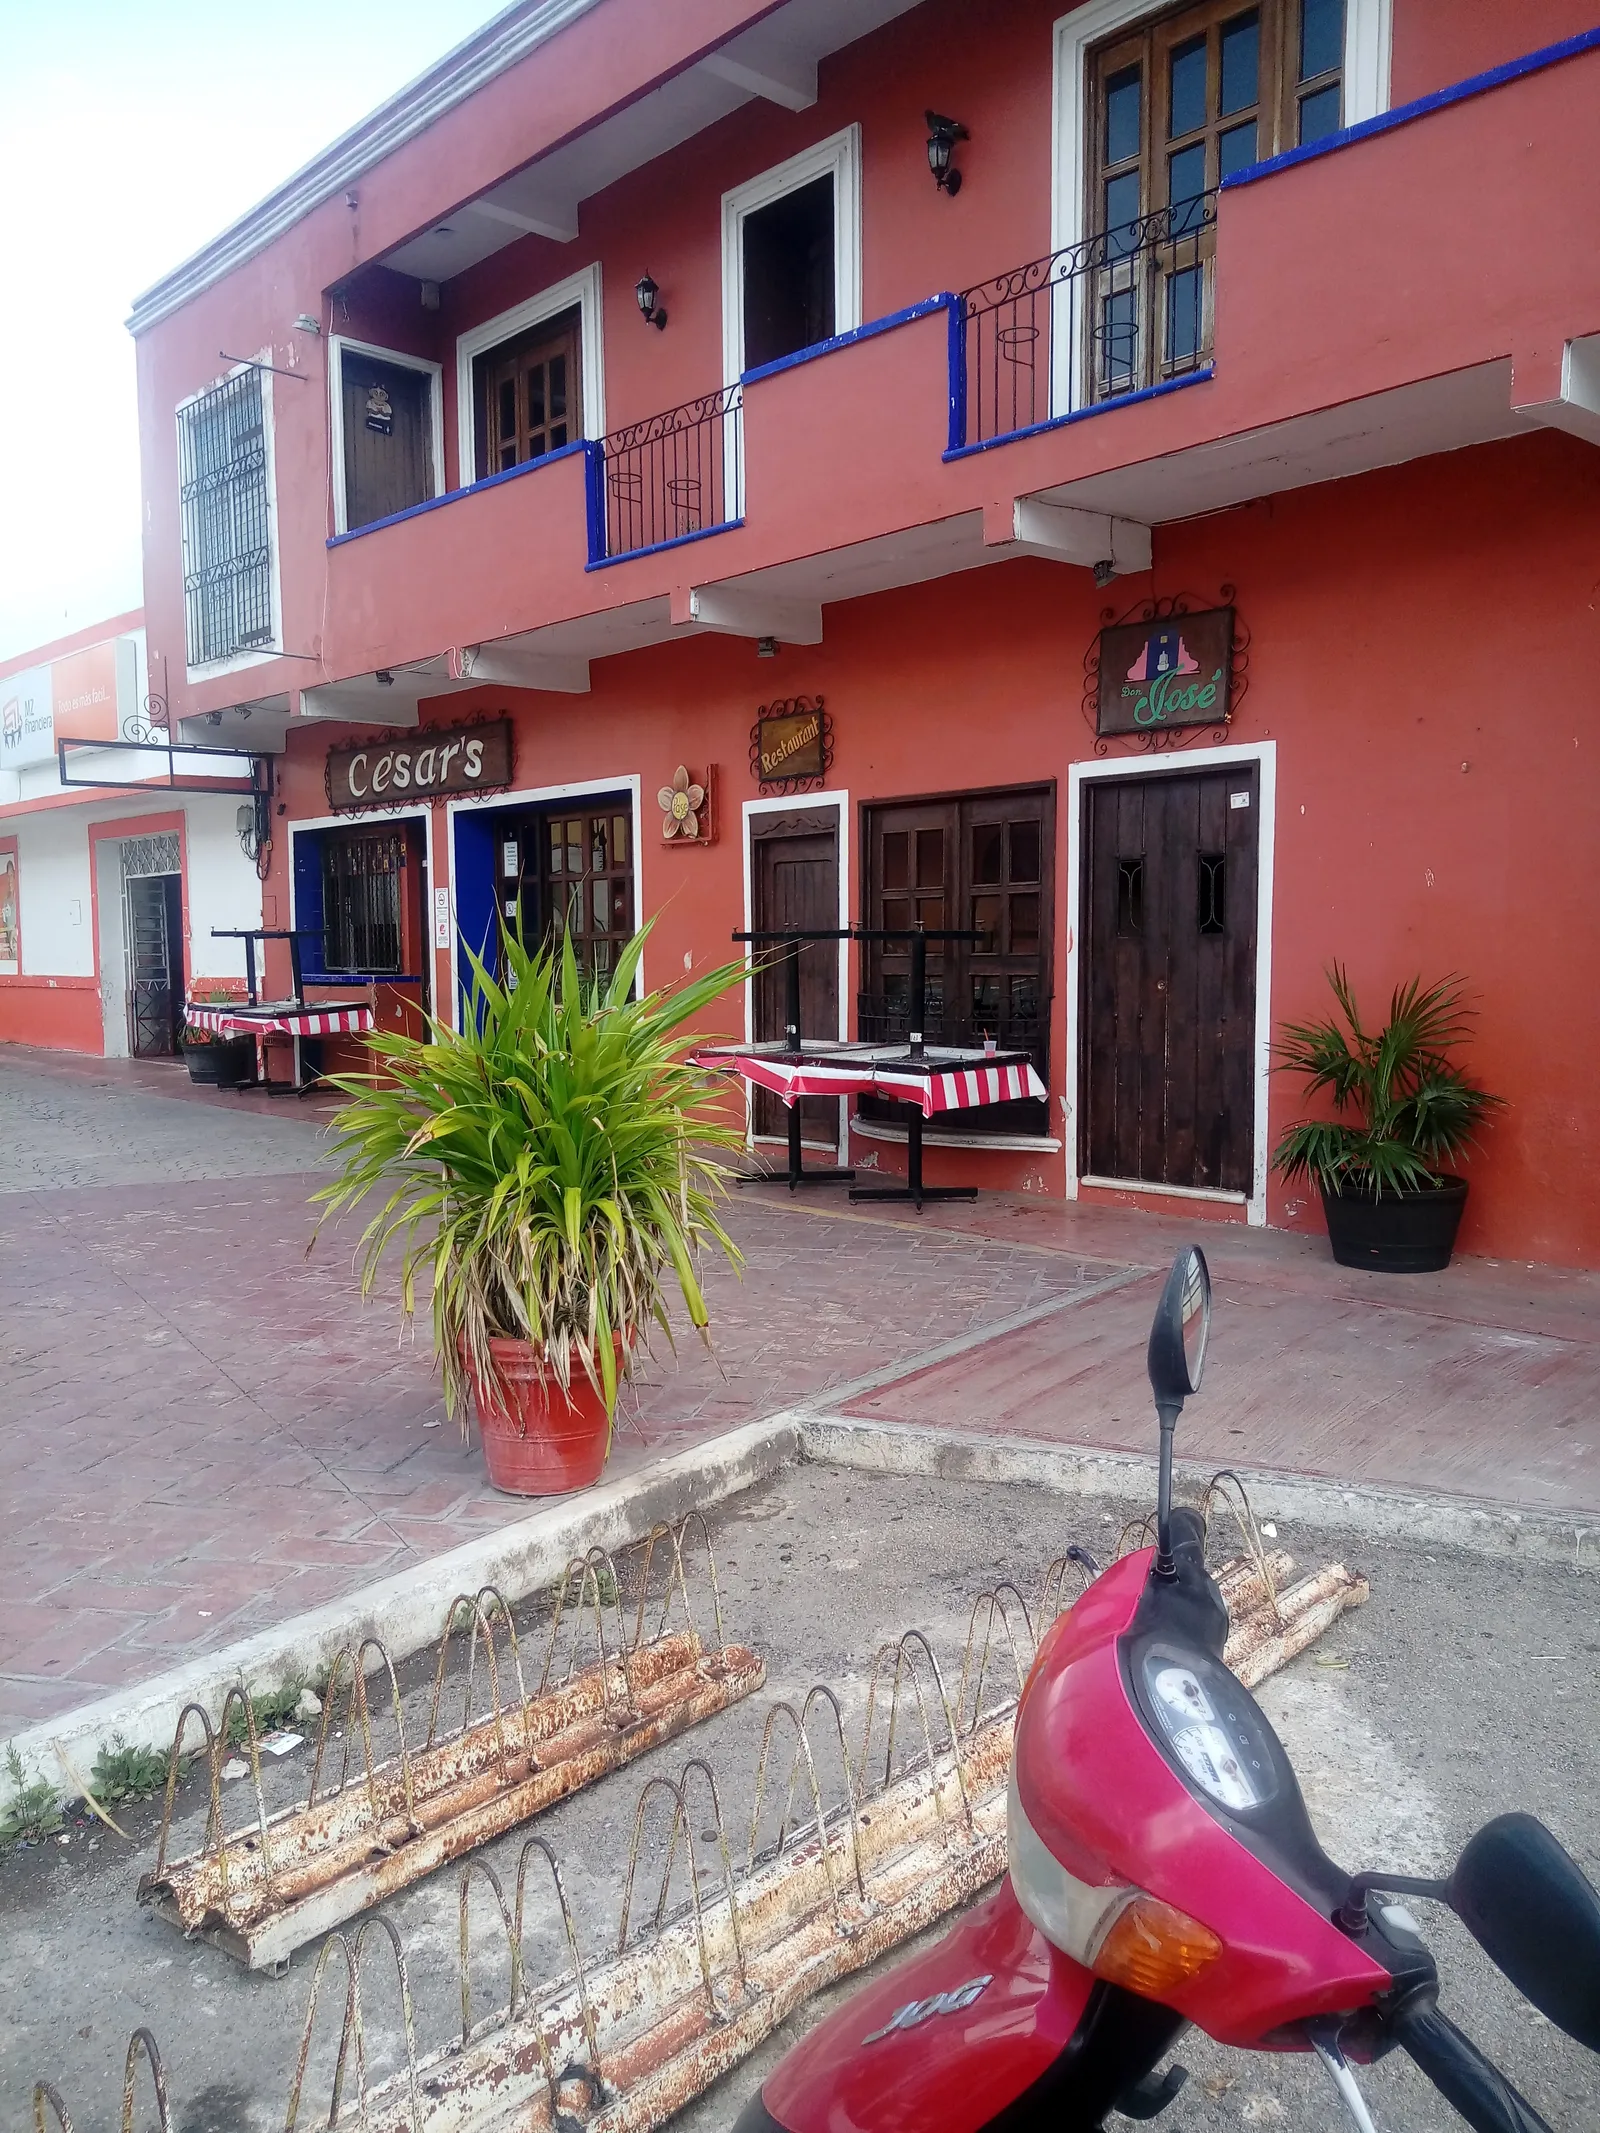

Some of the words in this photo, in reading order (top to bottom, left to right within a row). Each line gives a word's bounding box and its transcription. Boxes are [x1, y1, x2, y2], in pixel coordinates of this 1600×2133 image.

[24, 698, 35, 717] MZ
[58, 699, 72, 714] Todo
[71, 697, 80, 710] es
[79, 691, 92, 707] más
[1120, 686, 1143, 698] Don
[1133, 664, 1222, 726] José
[348, 735, 485, 798] César's
[761, 716, 820, 774] Restaurant
[861, 1973, 995, 2046] JOG
